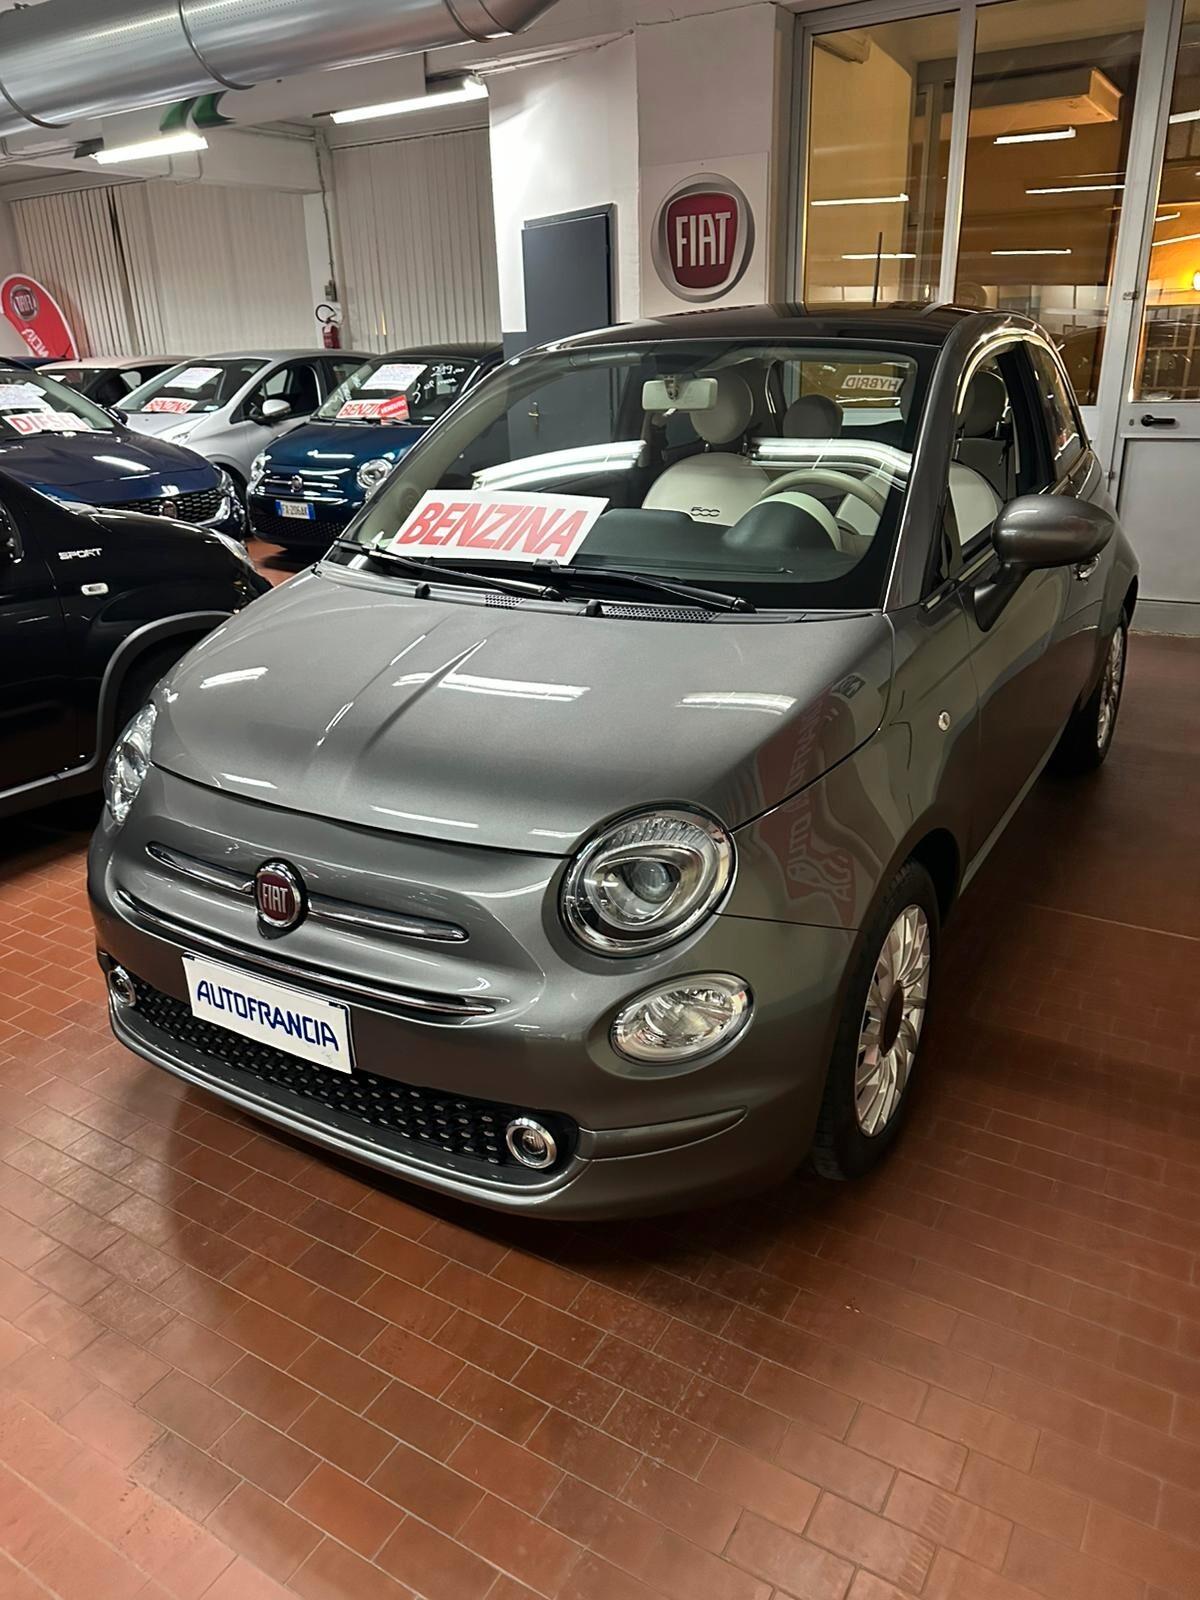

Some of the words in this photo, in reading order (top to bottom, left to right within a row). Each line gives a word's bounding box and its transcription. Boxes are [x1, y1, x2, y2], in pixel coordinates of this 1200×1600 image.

[675, 211, 732, 268] FIAT
[10, 413, 88, 433] DIESEL
[690, 506, 721, 518] 500
[396, 502, 589, 557] BENZINA
[58, 547, 103, 561] SPORT
[262, 883, 289, 914] FIAT
[197, 979, 340, 1052] AUTOFRANCIA
